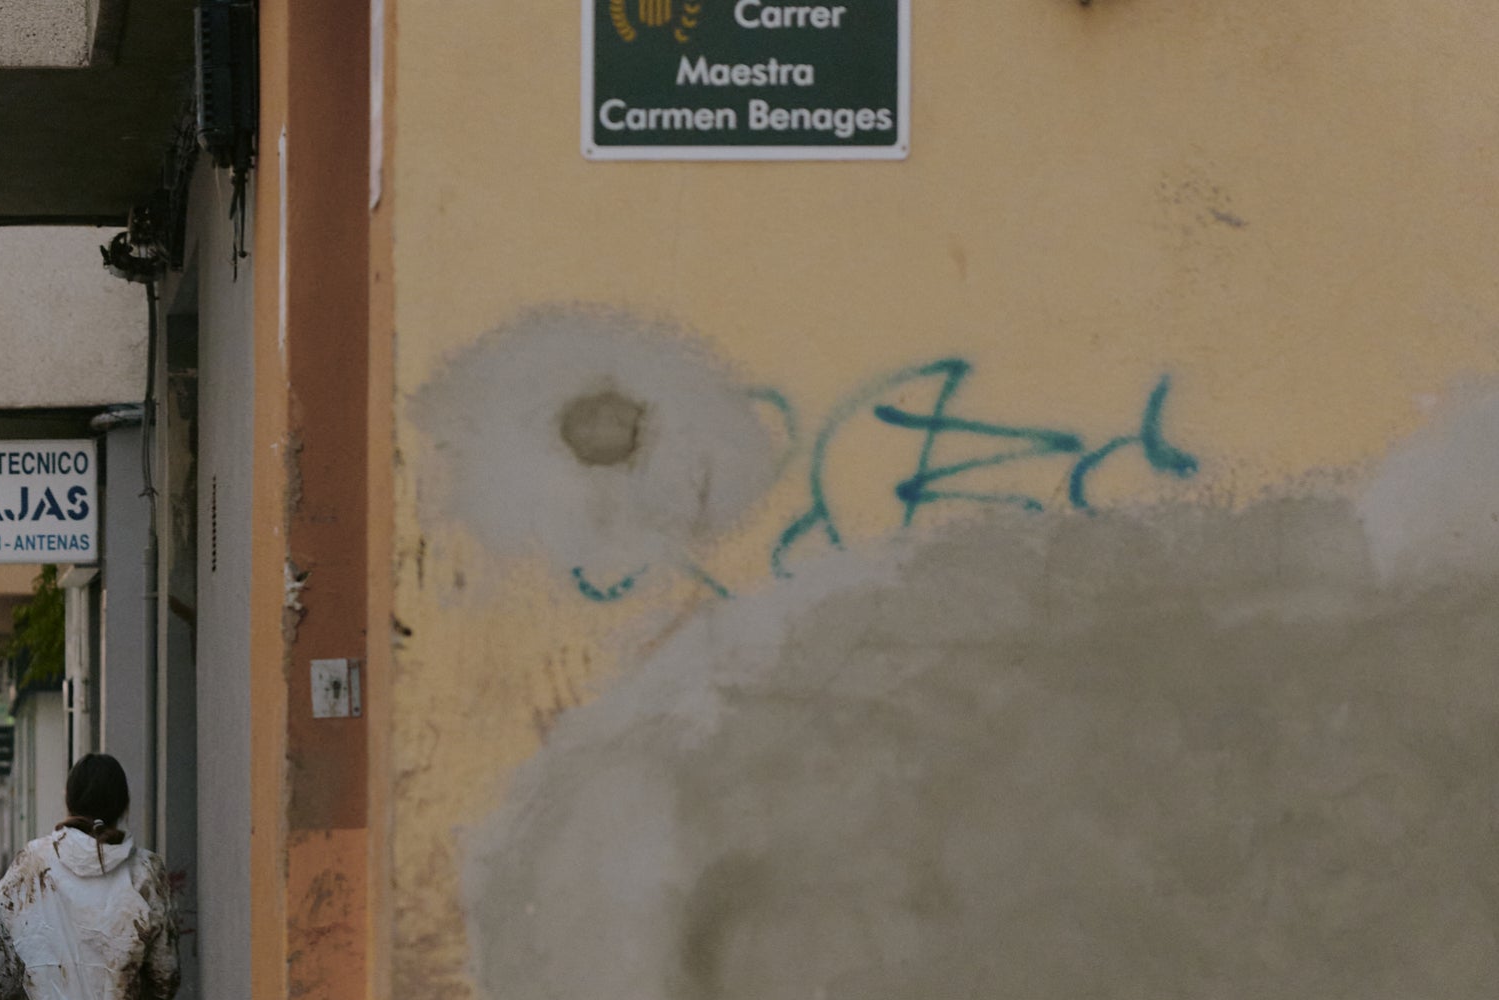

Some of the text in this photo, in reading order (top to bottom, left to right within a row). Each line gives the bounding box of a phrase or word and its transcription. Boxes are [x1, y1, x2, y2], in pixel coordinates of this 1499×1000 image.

[734, 0, 847, 29] Carrer
[676, 54, 815, 87] Maestra
[599, 98, 893, 139] Carmen Benages
